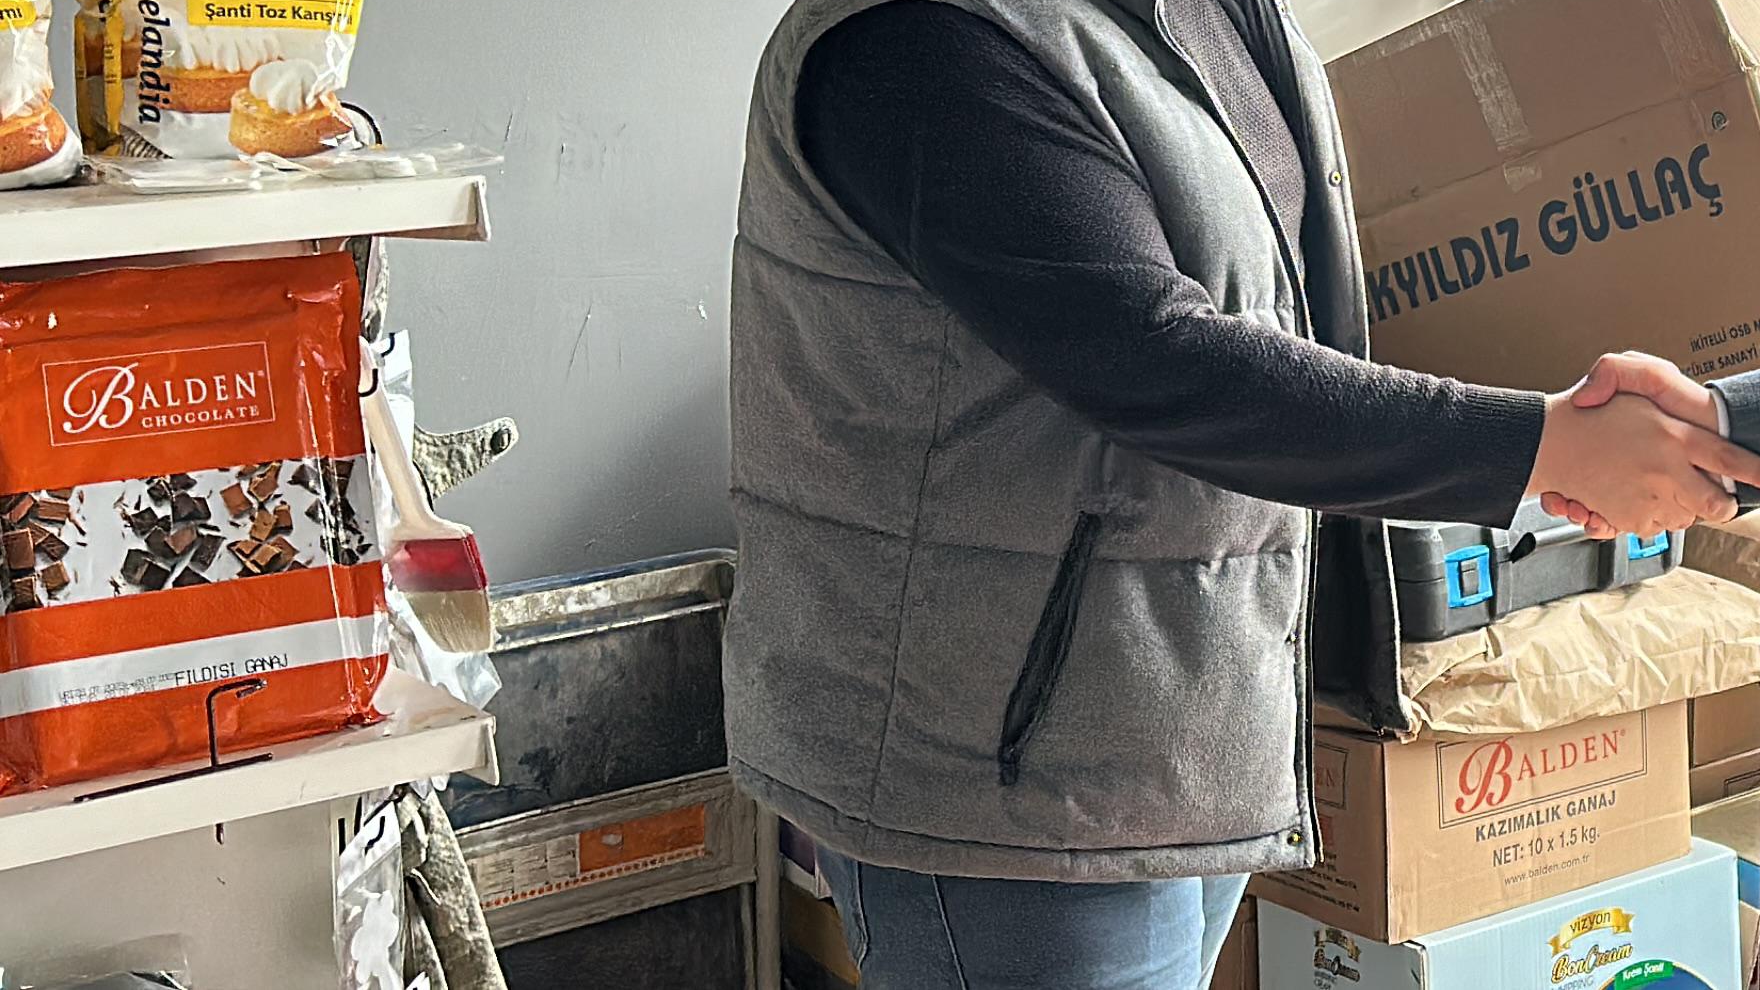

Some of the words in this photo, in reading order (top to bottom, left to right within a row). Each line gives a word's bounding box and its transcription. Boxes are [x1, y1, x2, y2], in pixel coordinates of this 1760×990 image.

[205, 3, 251, 21] Şanti
[256, 4, 286, 19] Toz
[1366, 217, 1531, 325] KYILDIZ
[1538, 142, 1724, 255] GÜLLAÇ
[1729, 323, 1751, 339] OSB
[1718, 343, 1758, 369] SANAYİ
[62, 362, 257, 433] BALDEN
[142, 405, 260, 428] CHOCOLATE
[175, 662, 236, 686] FILDISI
[245, 653, 288, 674] GANAJ
[1455, 730, 1620, 814] BALDEN
[1475, 804, 1562, 842] KAZIMALIK
[1566, 790, 1616, 817] GANAJ
[1493, 843, 1524, 867] NET:
[1528, 837, 1543, 857] 10
[1547, 840, 1555, 851] x
[1560, 830, 1577, 849] 1.5
[1581, 824, 1600, 844] kg.
[1570, 912, 1611, 933] vizyon
